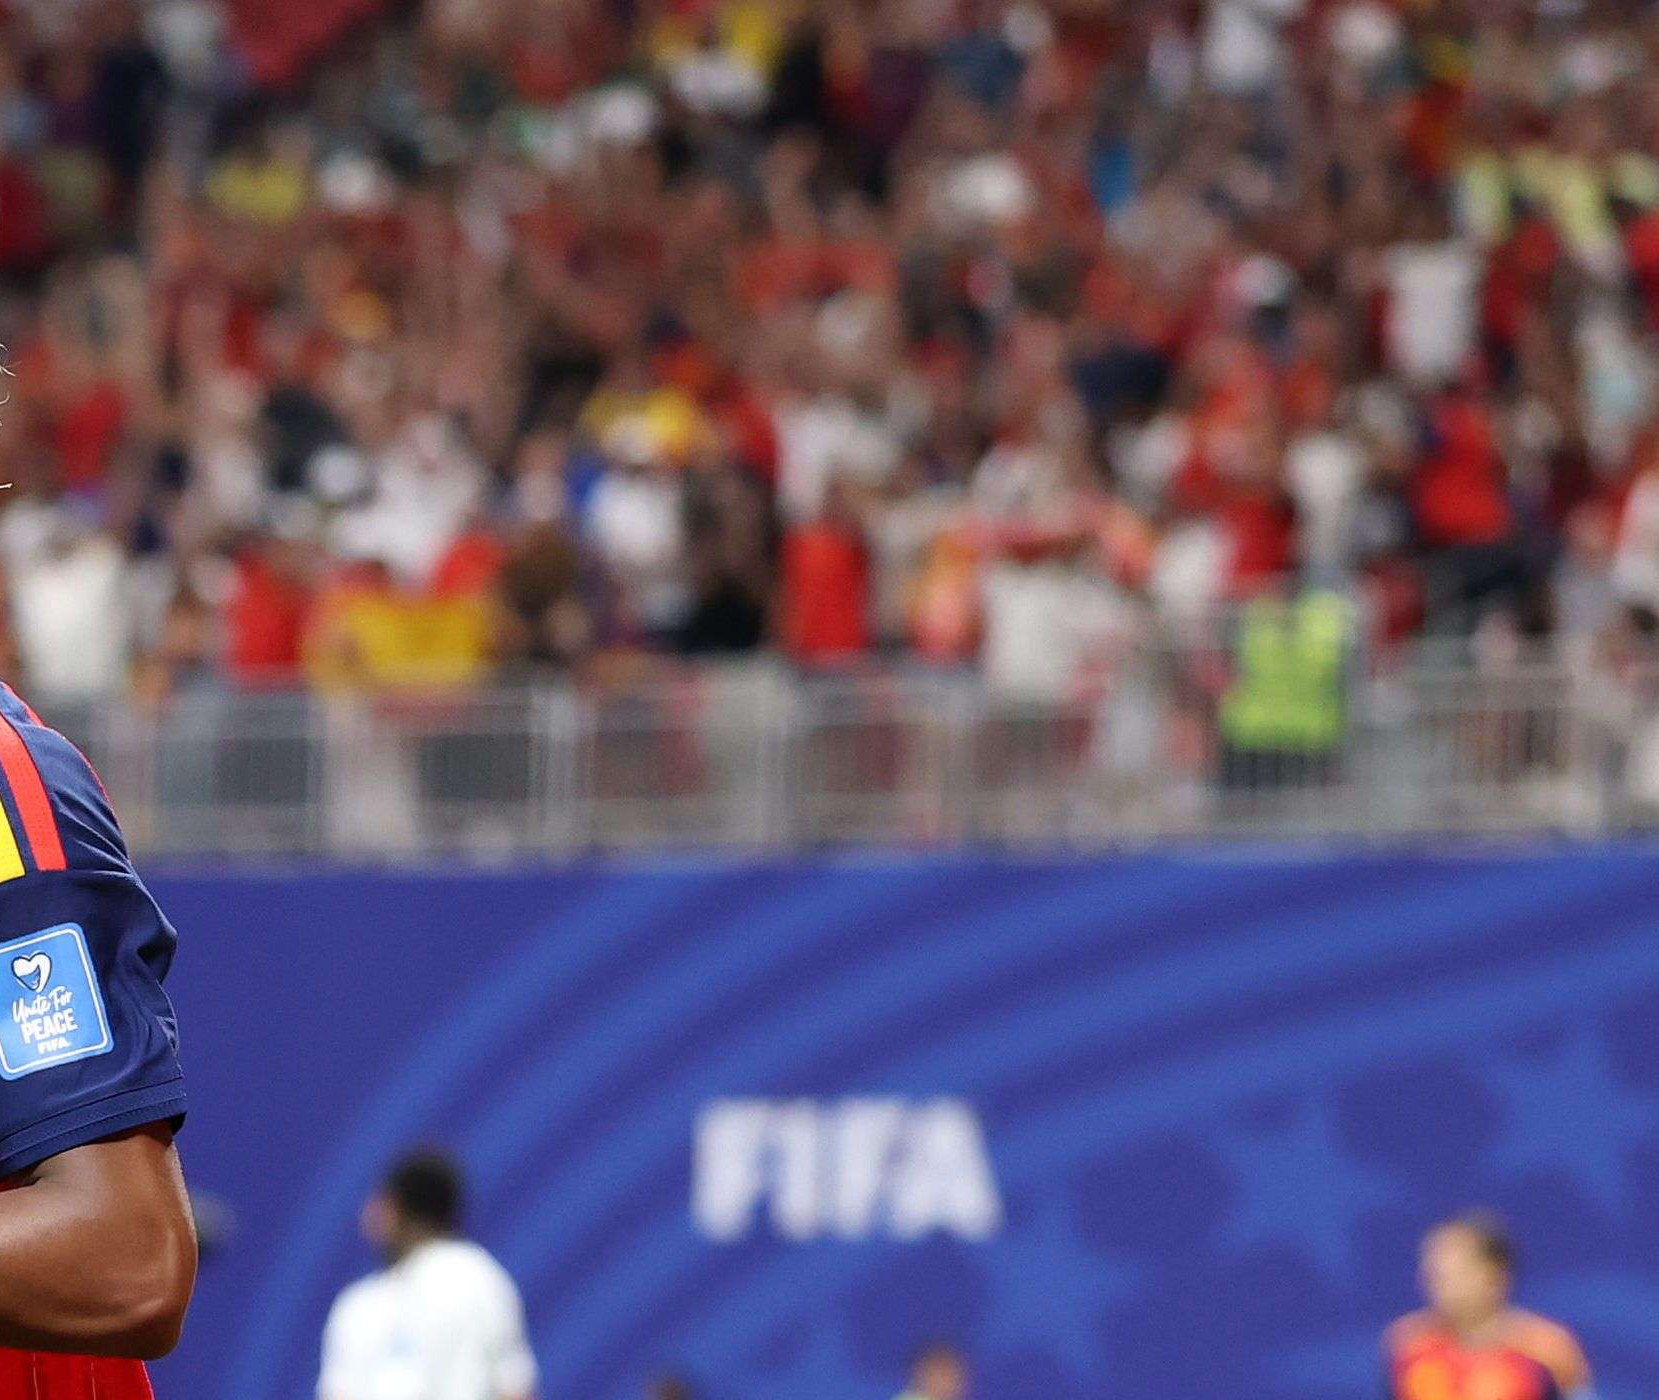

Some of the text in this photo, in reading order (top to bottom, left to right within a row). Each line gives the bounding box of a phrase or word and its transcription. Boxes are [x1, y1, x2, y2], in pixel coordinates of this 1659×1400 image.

[48, 986, 73, 1011] For
[21, 1008, 78, 1044] PEACE
[37, 1036, 72, 1054] FIFA
[691, 1096, 1003, 1241] FIFA
